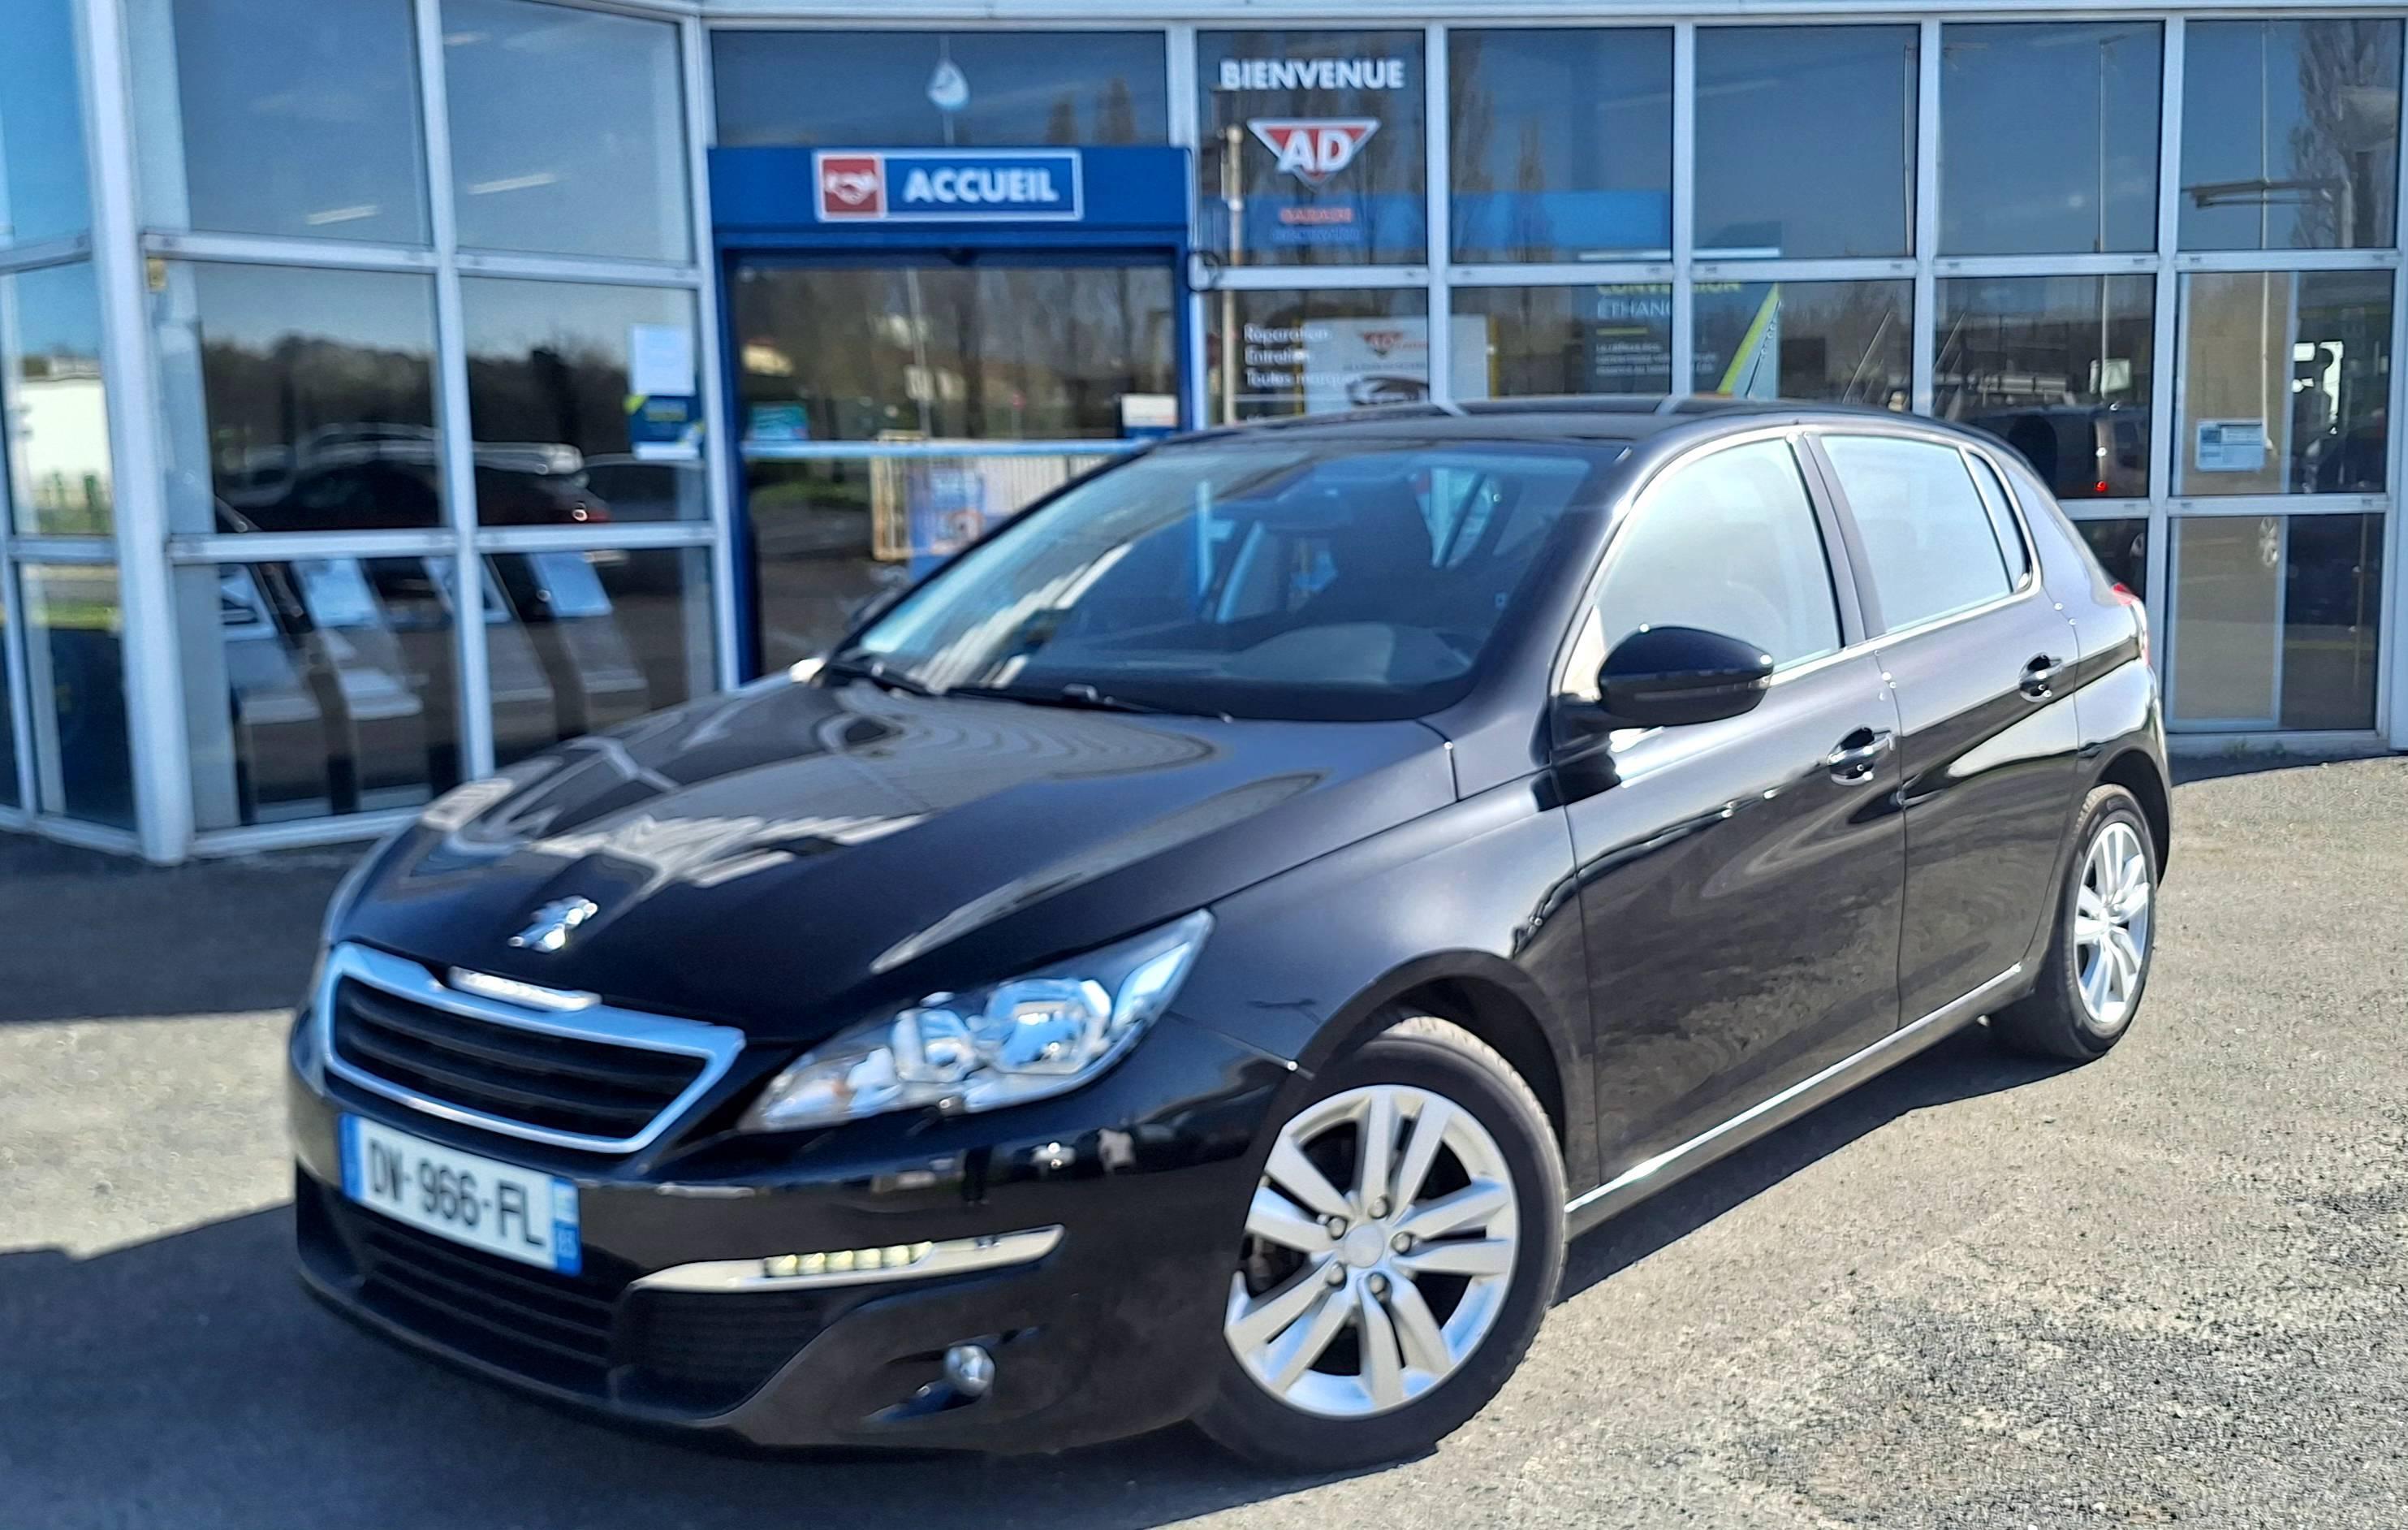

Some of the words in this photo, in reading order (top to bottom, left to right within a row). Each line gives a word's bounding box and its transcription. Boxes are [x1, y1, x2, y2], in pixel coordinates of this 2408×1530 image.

[1219, 58, 1405, 89] BIENVENUE
[1276, 127, 1352, 173] AD
[904, 167, 1059, 203] ACCUEIL
